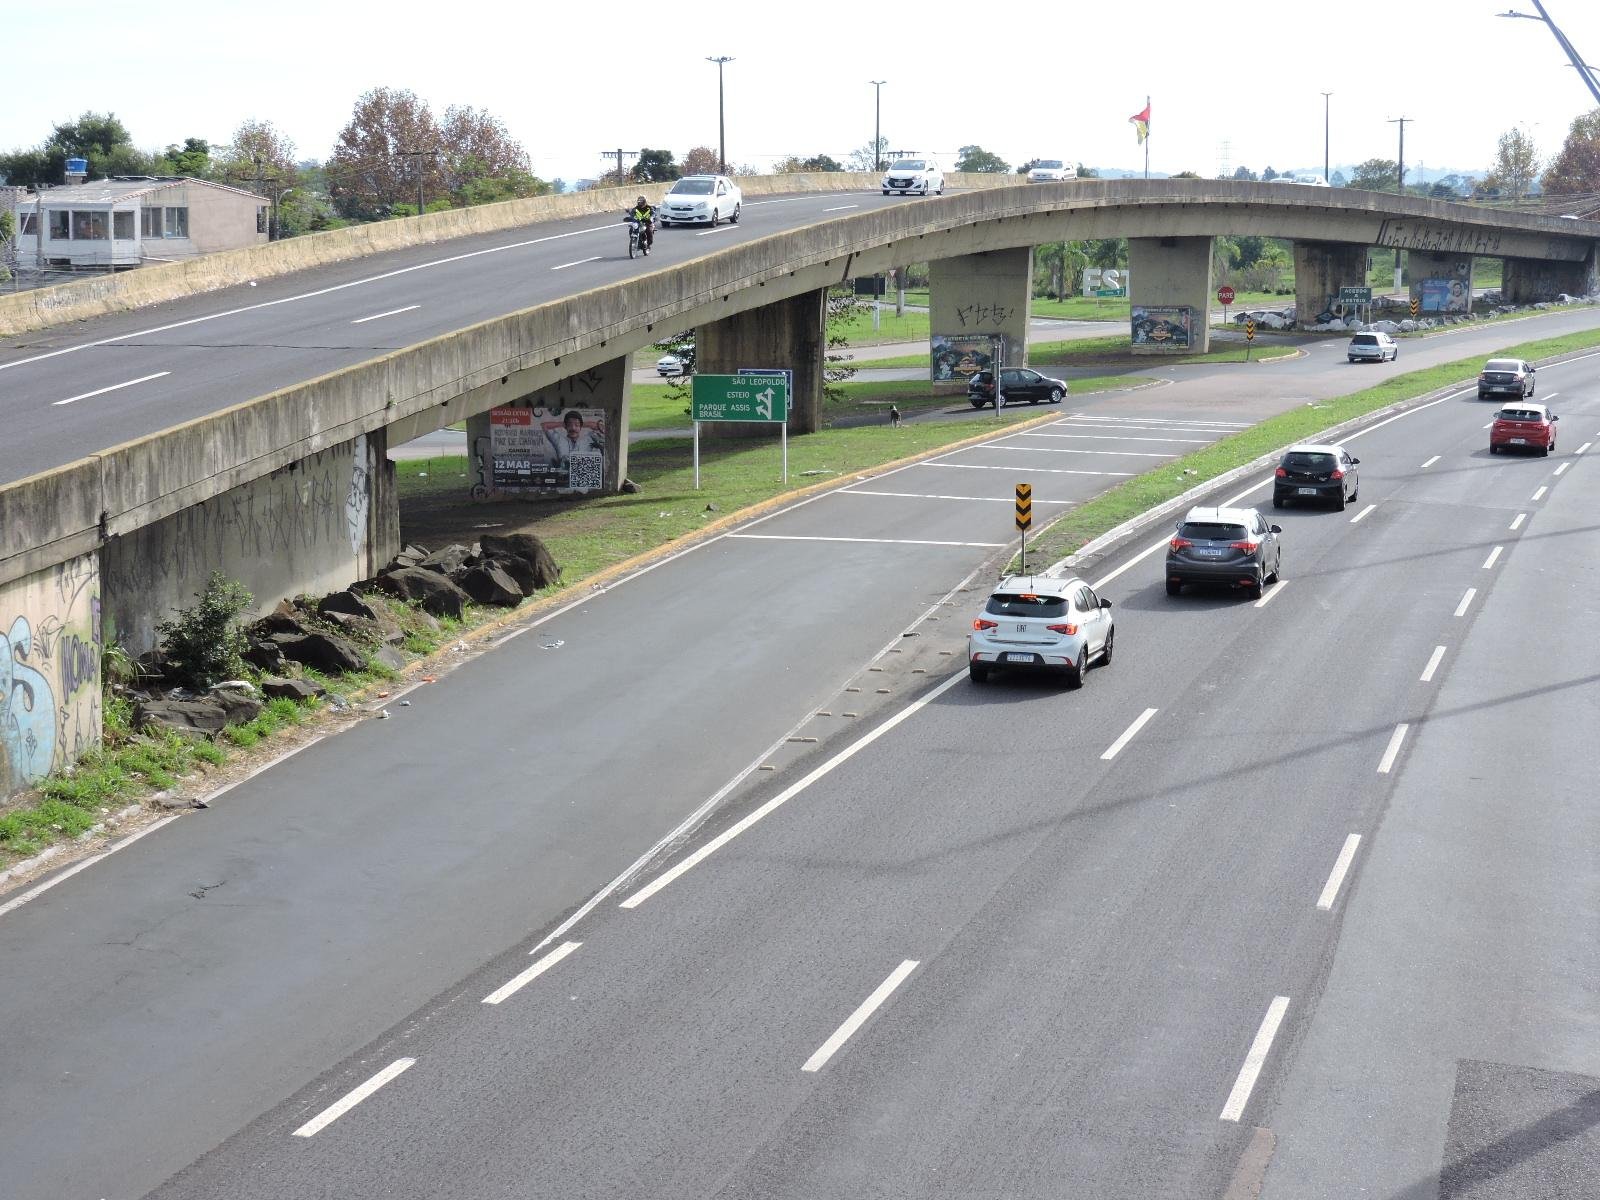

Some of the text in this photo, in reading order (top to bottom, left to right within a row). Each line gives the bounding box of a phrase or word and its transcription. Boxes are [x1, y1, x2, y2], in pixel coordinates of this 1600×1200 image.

[732, 376, 785, 386] SÃO LEOPOLDO
[730, 404, 751, 412] ASSIS
[494, 460, 505, 469] 12
[506, 460, 530, 469] MAR
